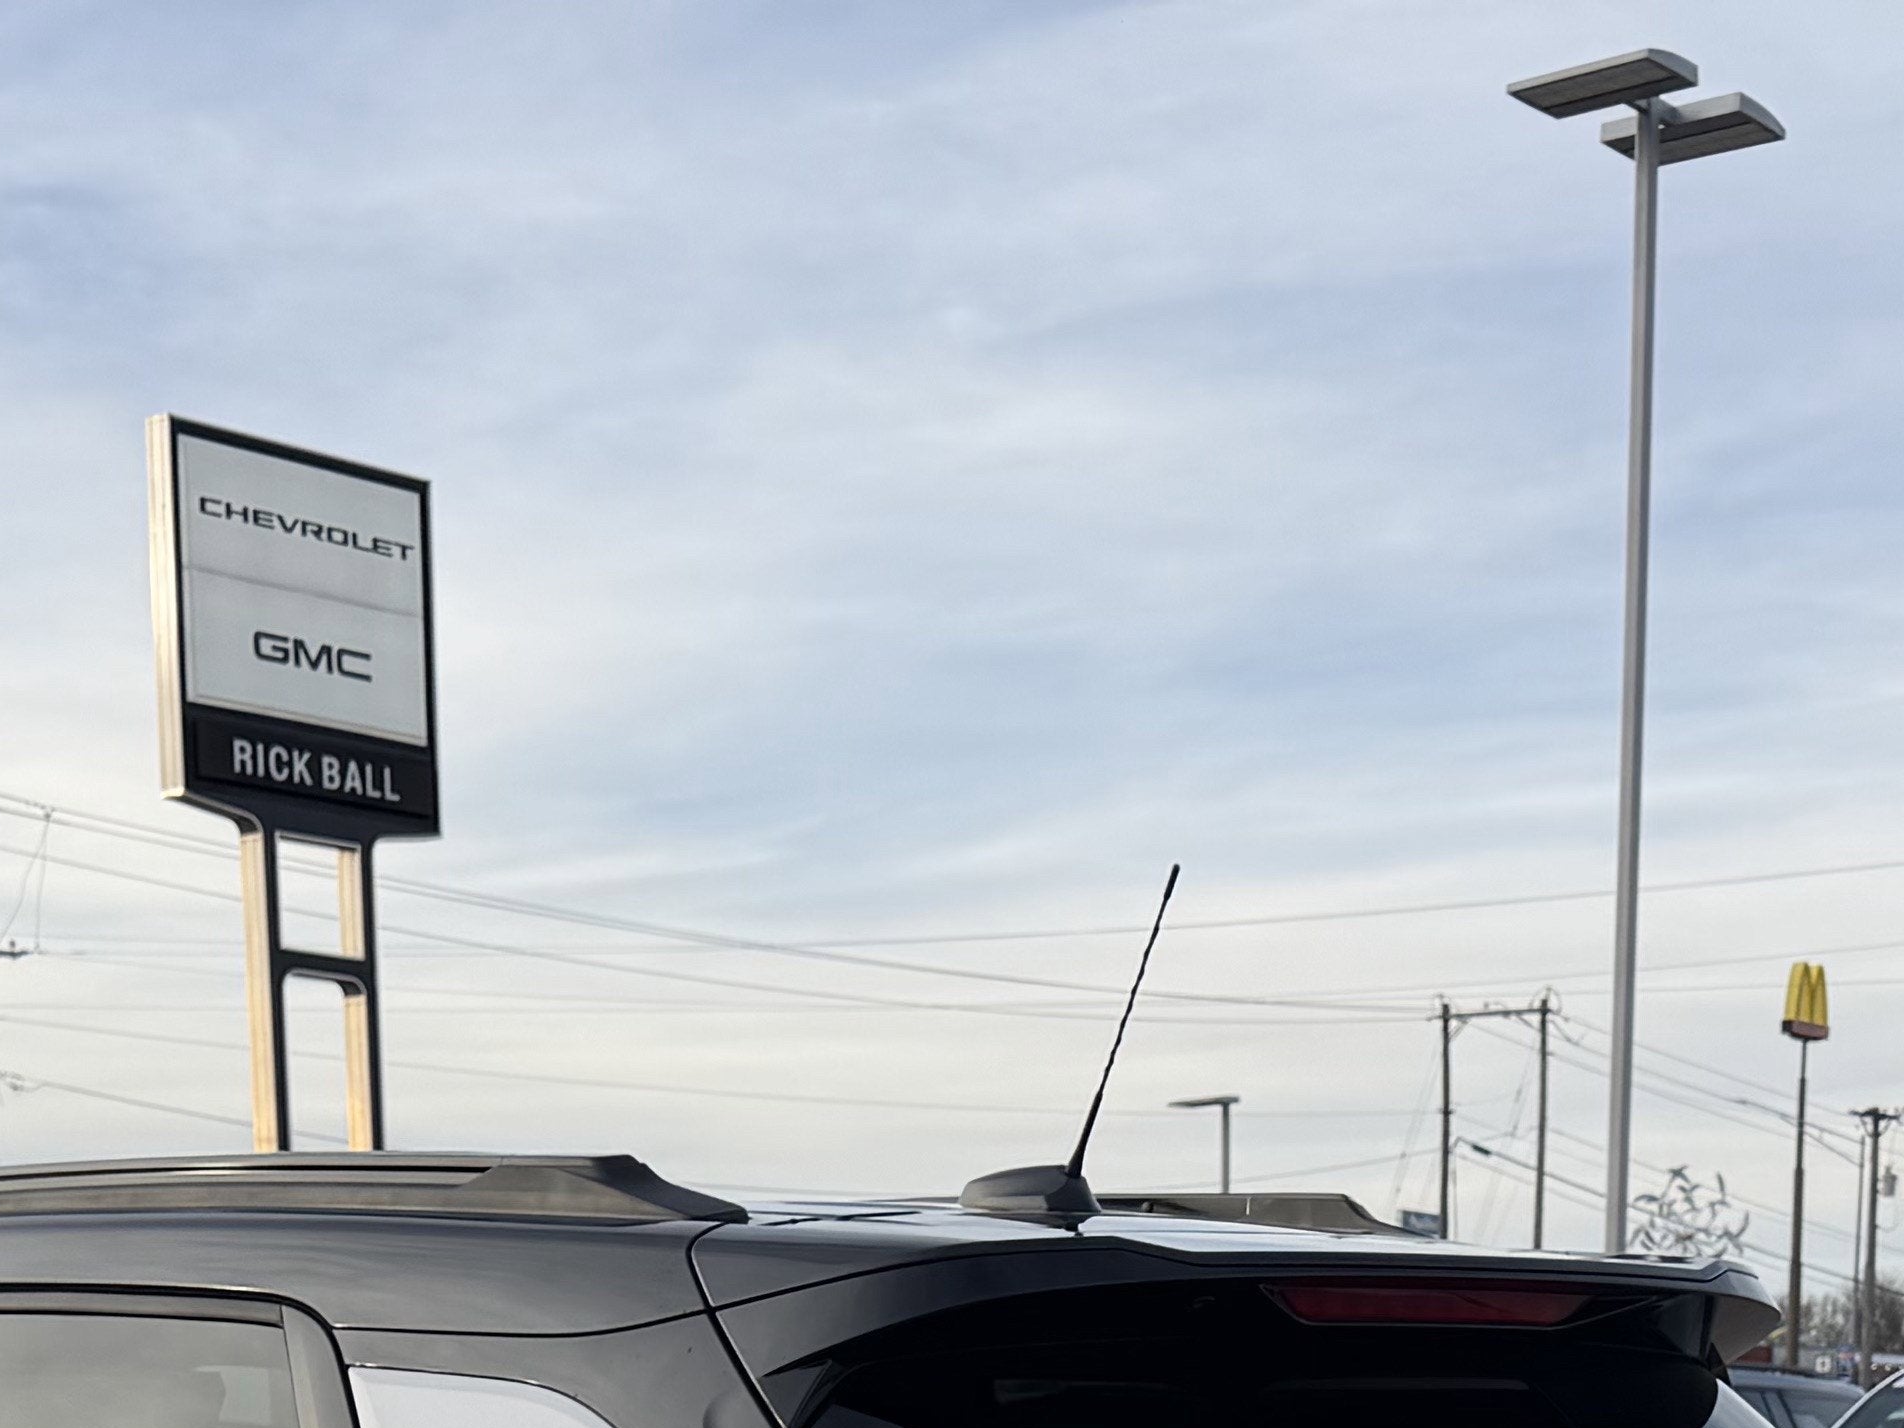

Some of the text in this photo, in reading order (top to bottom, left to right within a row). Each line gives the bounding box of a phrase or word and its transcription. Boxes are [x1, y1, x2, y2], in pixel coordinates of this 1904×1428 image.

[199, 496, 415, 561] CHEVROLET
[253, 630, 373, 682] GMC
[232, 737, 401, 801] RICK BALL
